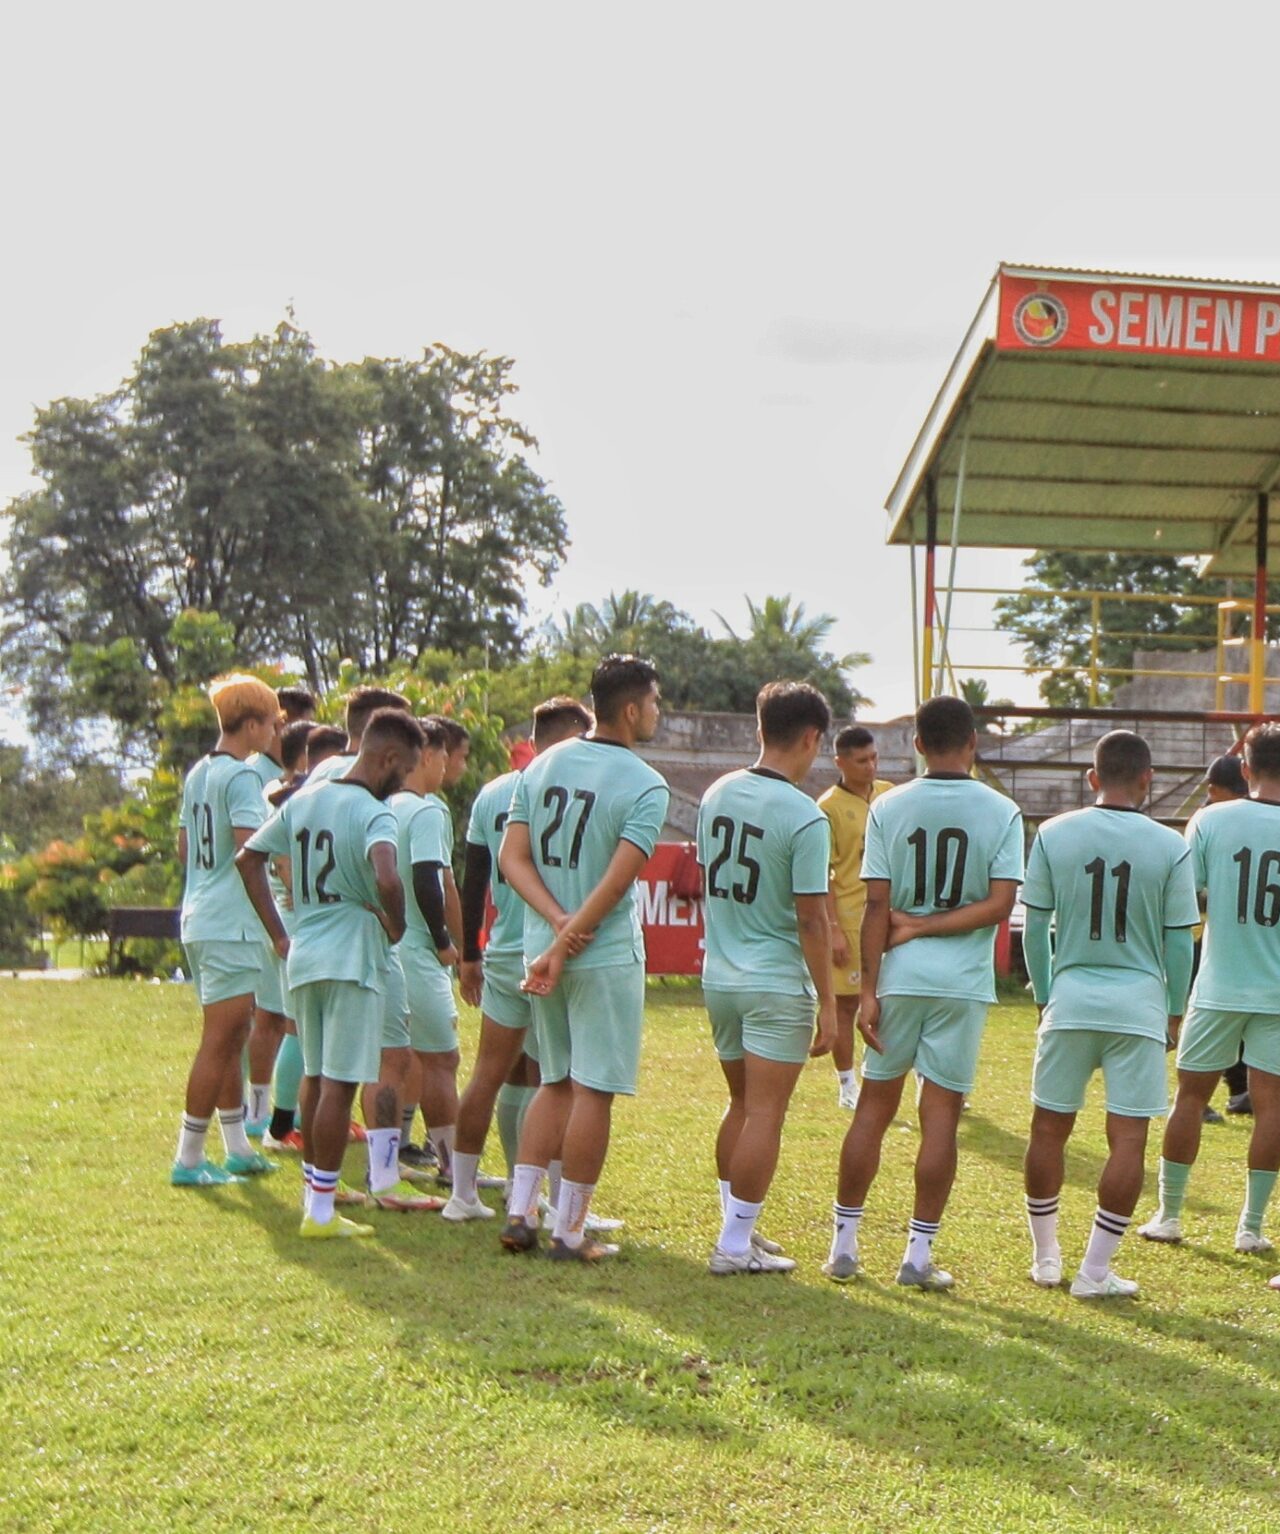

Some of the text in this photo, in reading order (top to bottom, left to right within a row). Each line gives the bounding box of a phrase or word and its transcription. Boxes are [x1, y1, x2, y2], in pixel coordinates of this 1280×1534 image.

[1089, 290, 1242, 352] SEMEN
[192, 802, 215, 870] 19
[296, 826, 342, 904] 12
[541, 785, 596, 869] 27
[709, 816, 765, 905] 25
[907, 826, 968, 908] 10
[1084, 856, 1132, 943] 11
